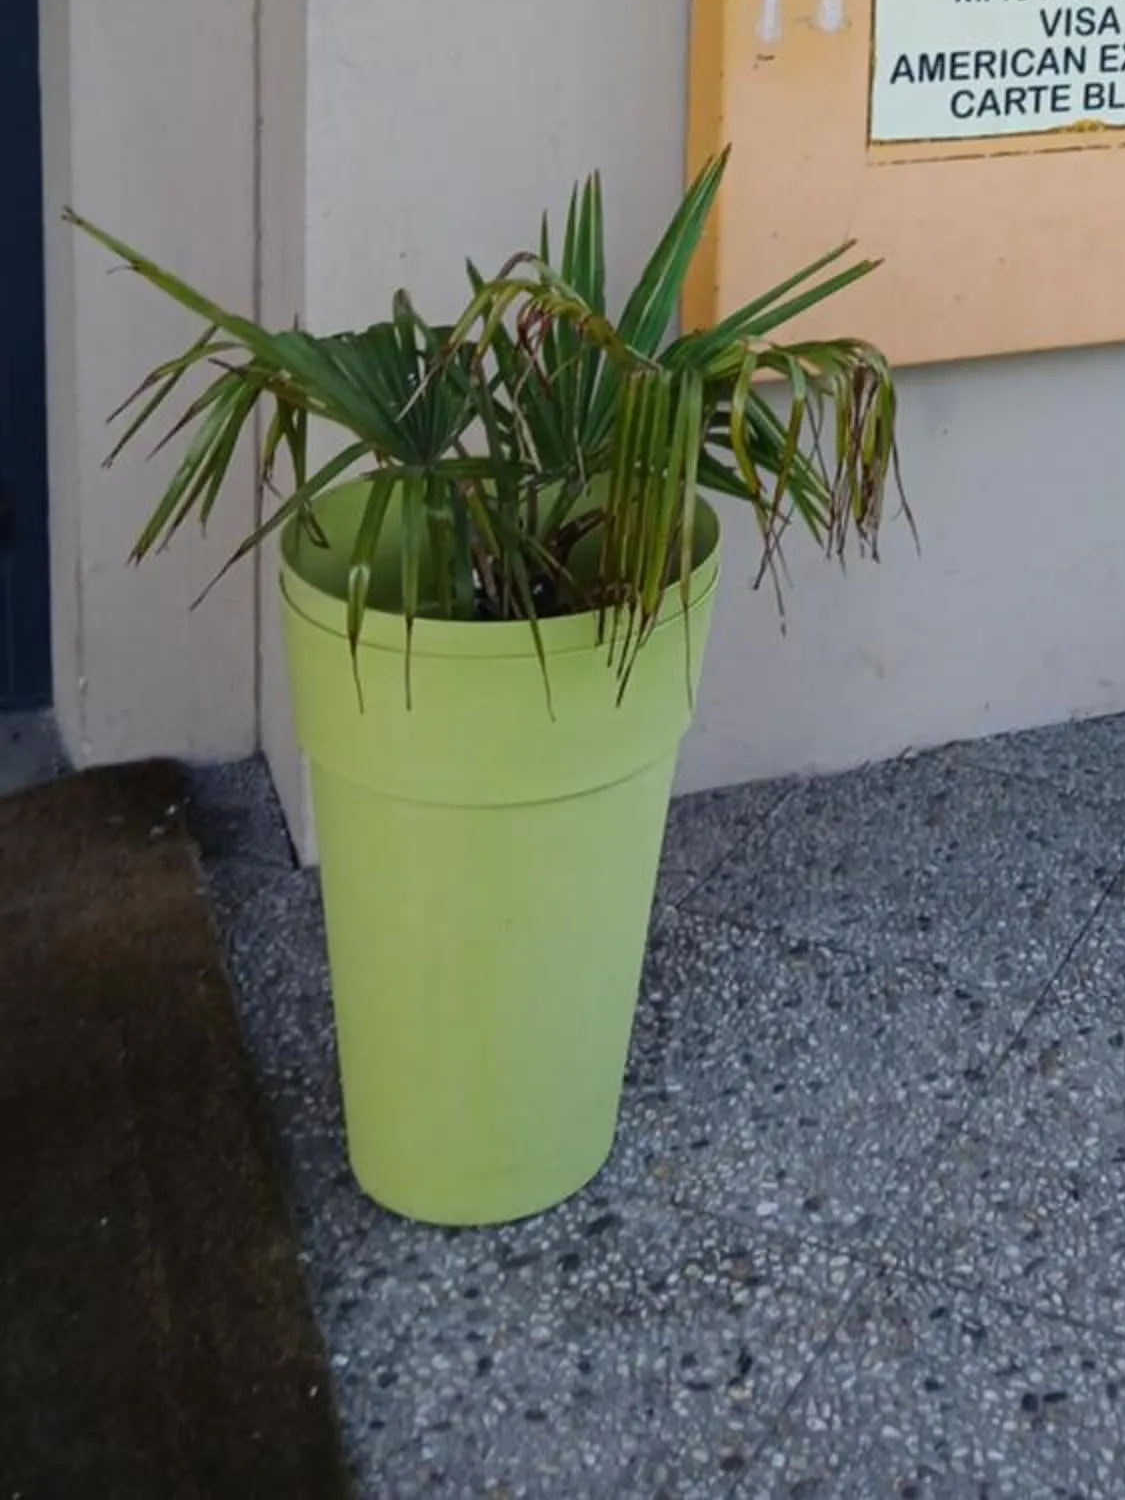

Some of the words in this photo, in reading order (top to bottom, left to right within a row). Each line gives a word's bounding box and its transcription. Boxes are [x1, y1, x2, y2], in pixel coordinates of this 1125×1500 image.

[1039, 6, 1121, 38] VISA
[889, 45, 1087, 85] AMERICAN
[950, 84, 1071, 119] CARTE
